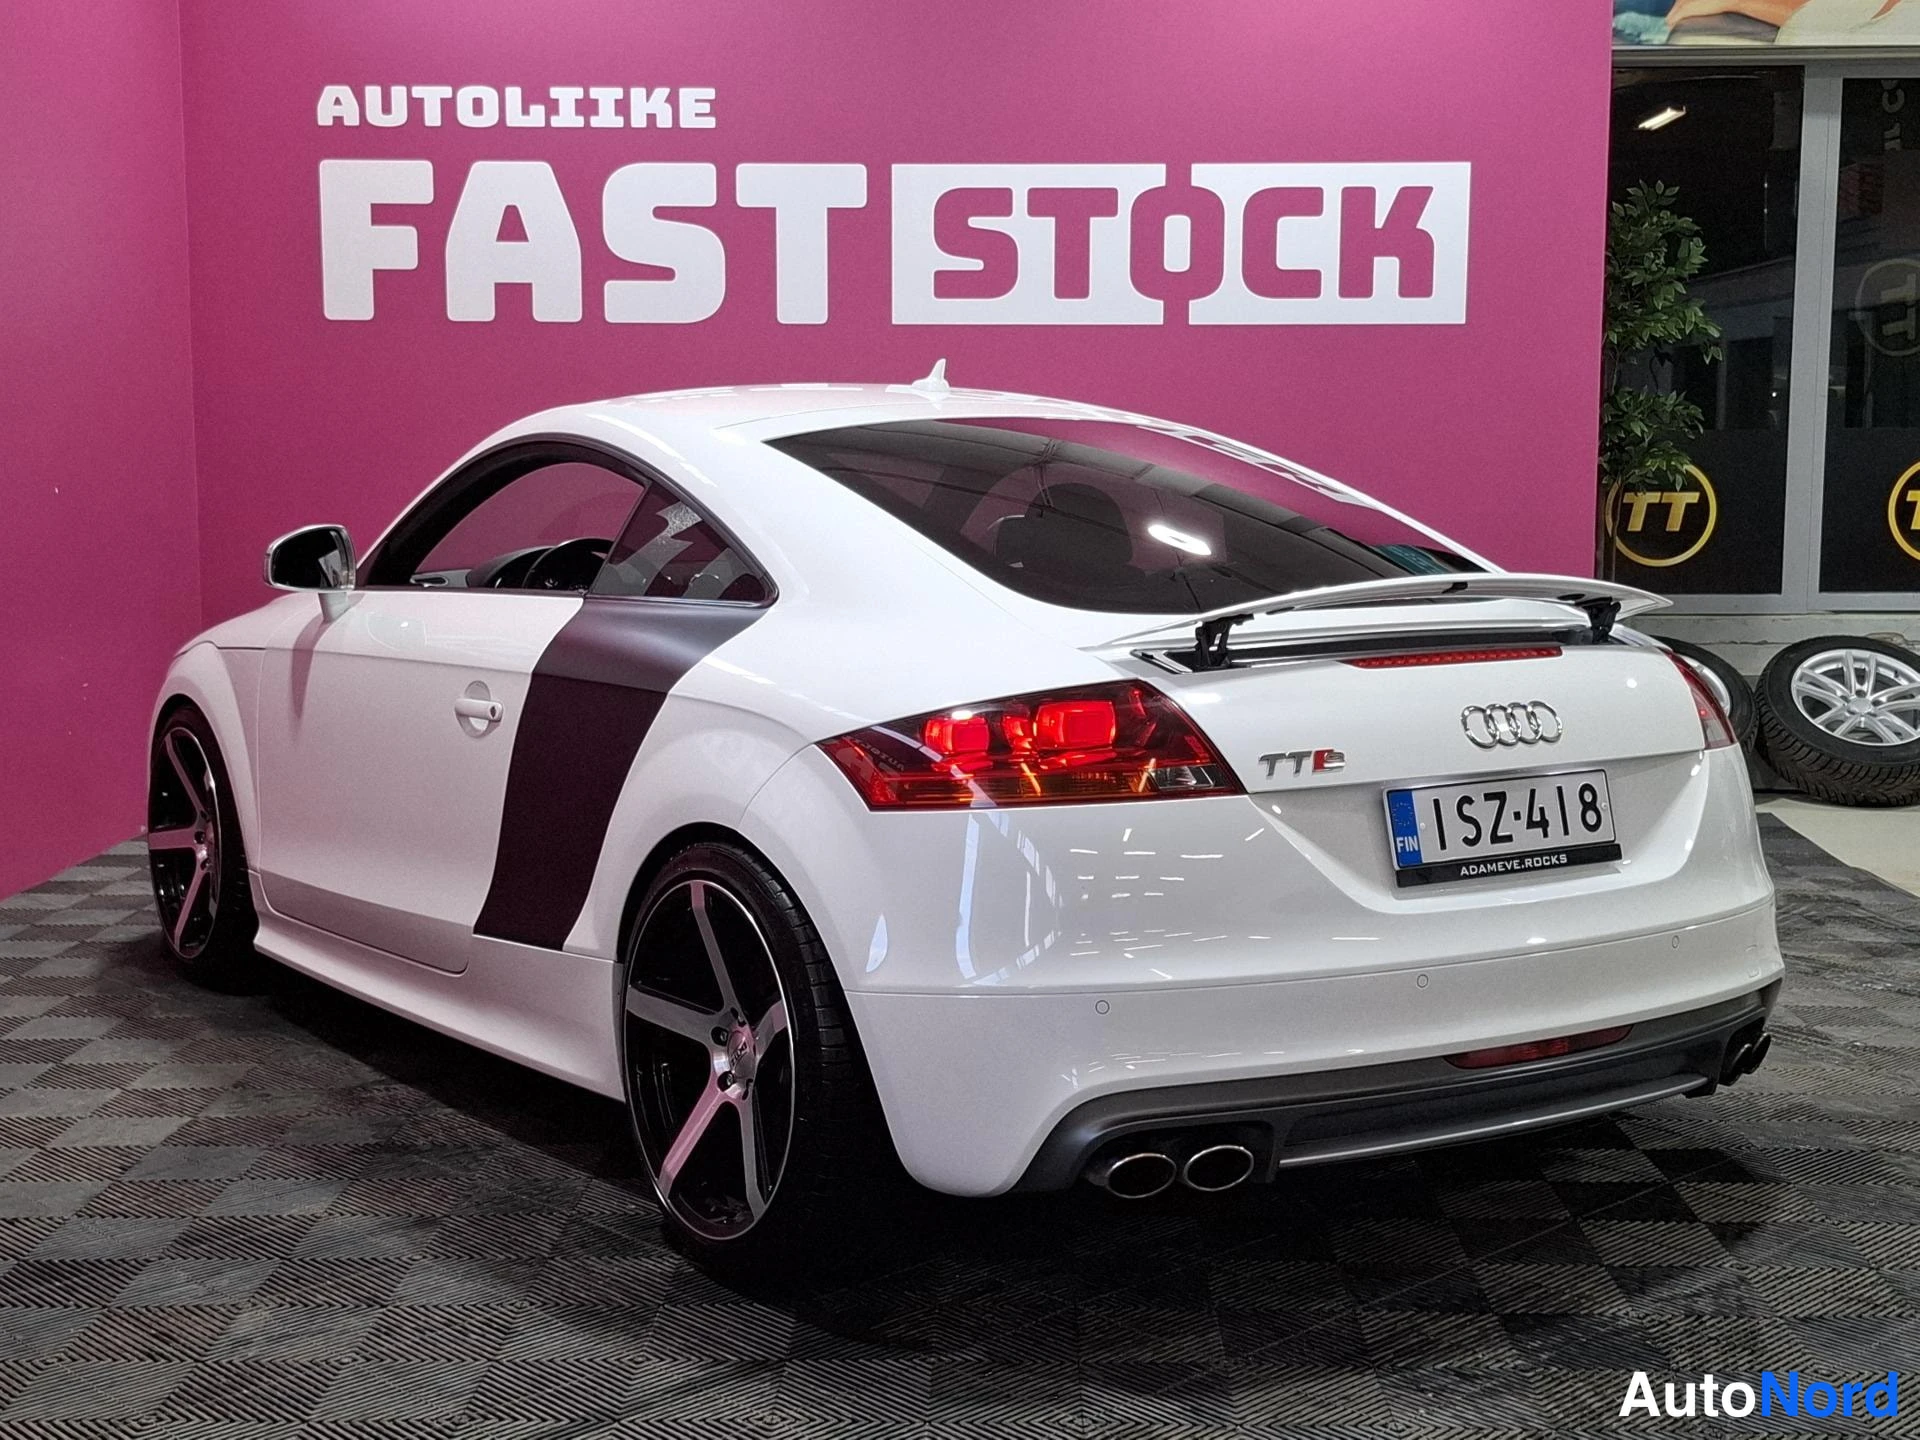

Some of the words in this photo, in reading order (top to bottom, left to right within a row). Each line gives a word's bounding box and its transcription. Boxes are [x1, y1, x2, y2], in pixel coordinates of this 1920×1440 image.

[317, 85, 716, 128] AUTOLIIKE
[319, 159, 868, 325] FAST
[932, 186, 1436, 301] STOCK
[1622, 491, 1700, 532] TT
[1258, 747, 1346, 777] TTS
[1396, 835, 1419, 853] FIN
[1433, 782, 1603, 851] ISZ-418
[1459, 853, 1568, 877] ADAMEVE.ROCKS
